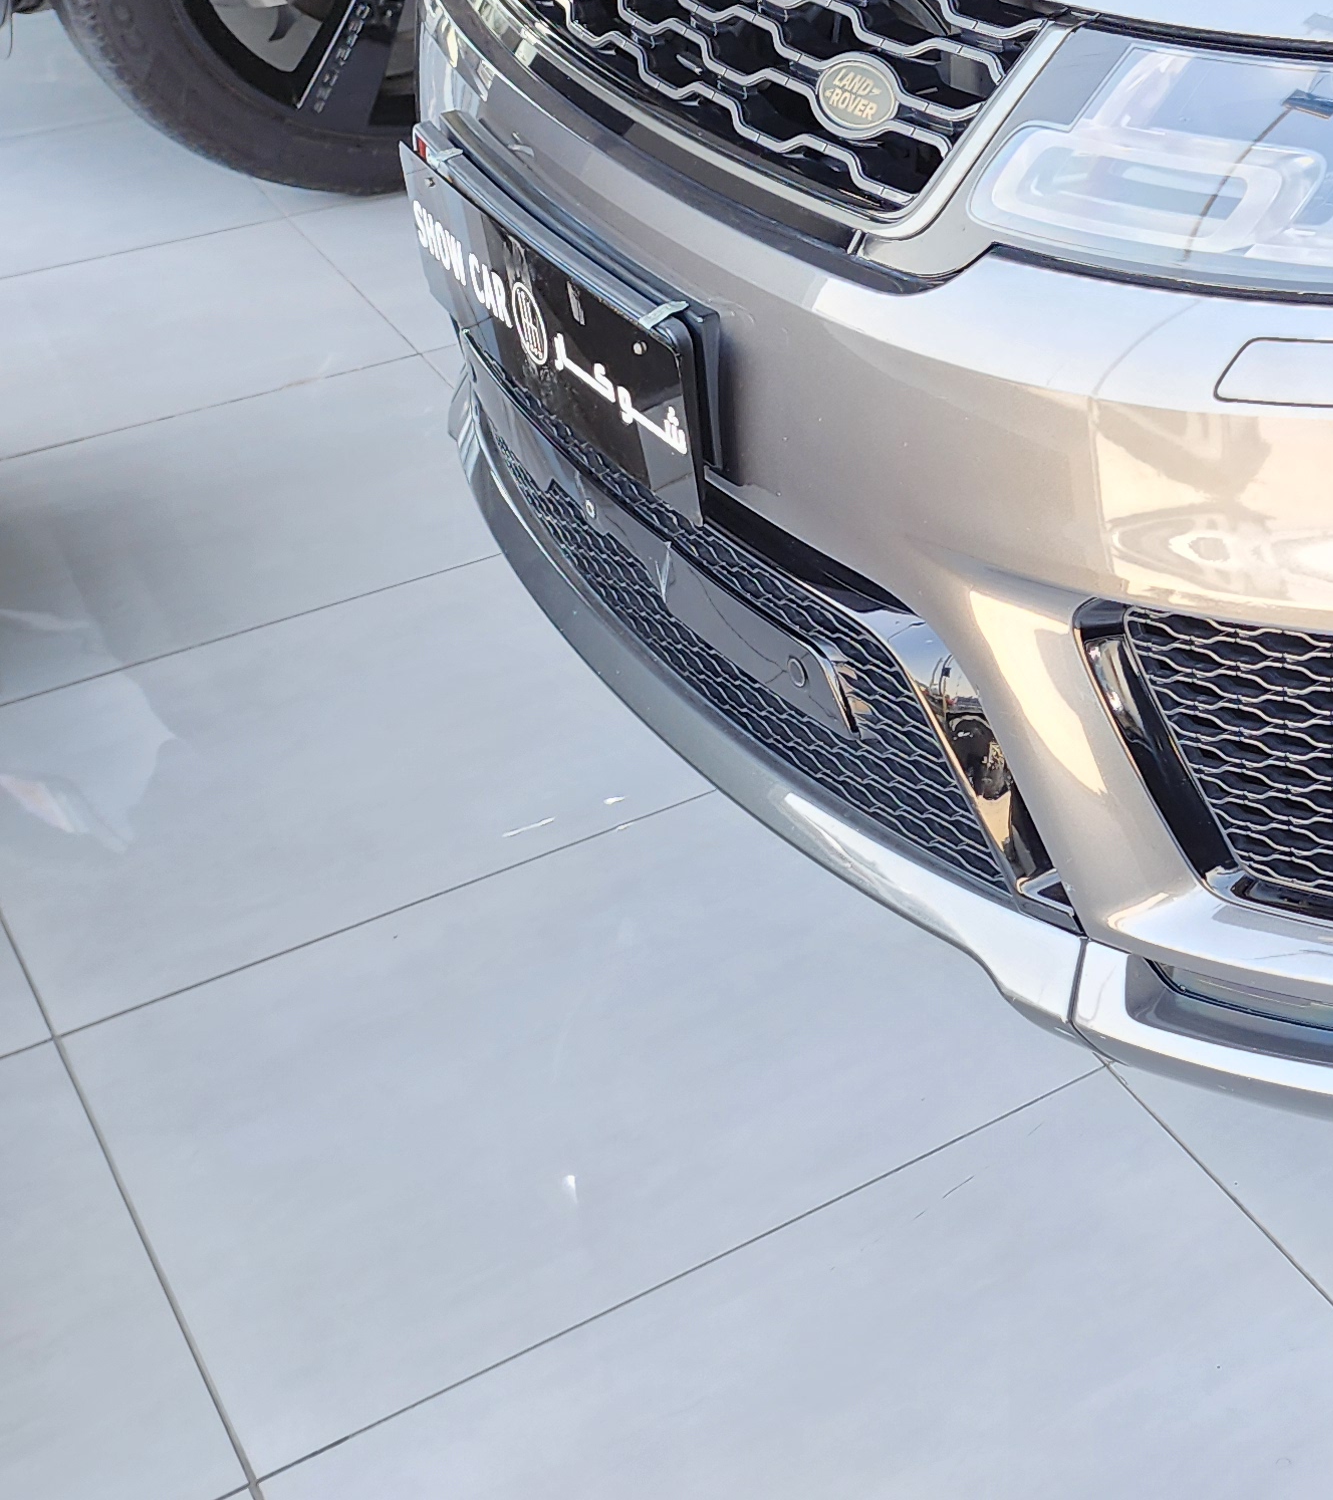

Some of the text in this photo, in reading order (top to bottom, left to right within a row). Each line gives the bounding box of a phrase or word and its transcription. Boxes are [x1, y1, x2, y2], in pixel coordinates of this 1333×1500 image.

[833, 68, 875, 96] LAND
[829, 87, 879, 121] ROVER
[412, 199, 514, 330] SHOW CAR
